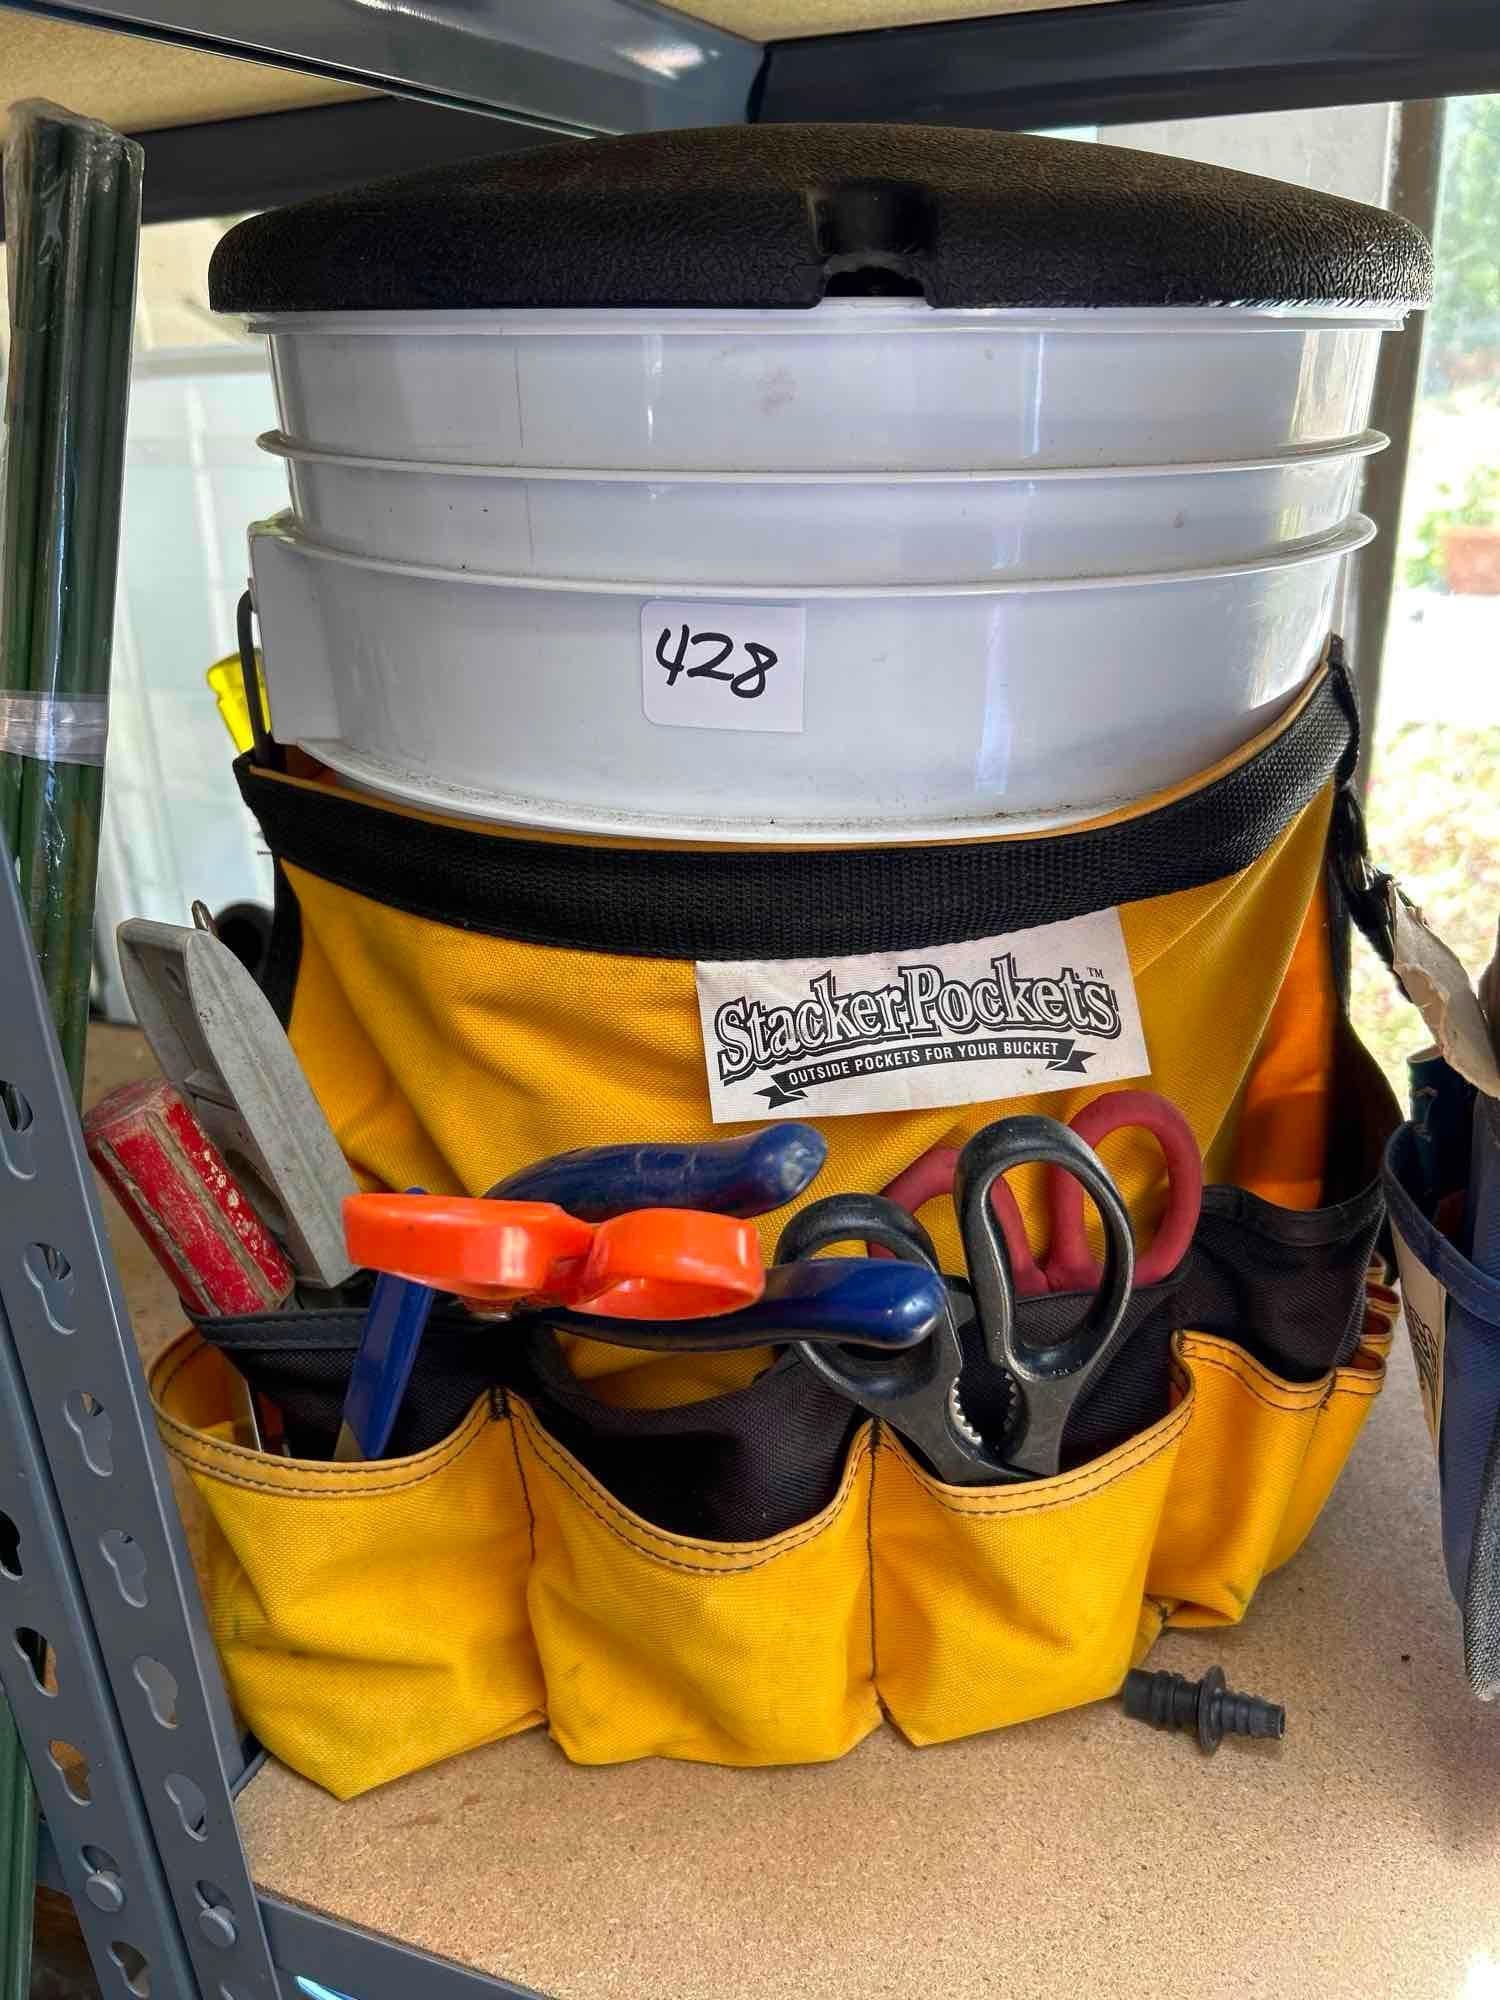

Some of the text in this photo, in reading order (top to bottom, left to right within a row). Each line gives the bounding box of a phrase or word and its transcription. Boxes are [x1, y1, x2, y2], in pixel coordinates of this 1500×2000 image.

[655, 623, 778, 699] 428
[714, 952, 1122, 1086] StackerPockets
[788, 1041, 1059, 1085] OUTSIDE POCKETS FOR YOUR BUCKET
